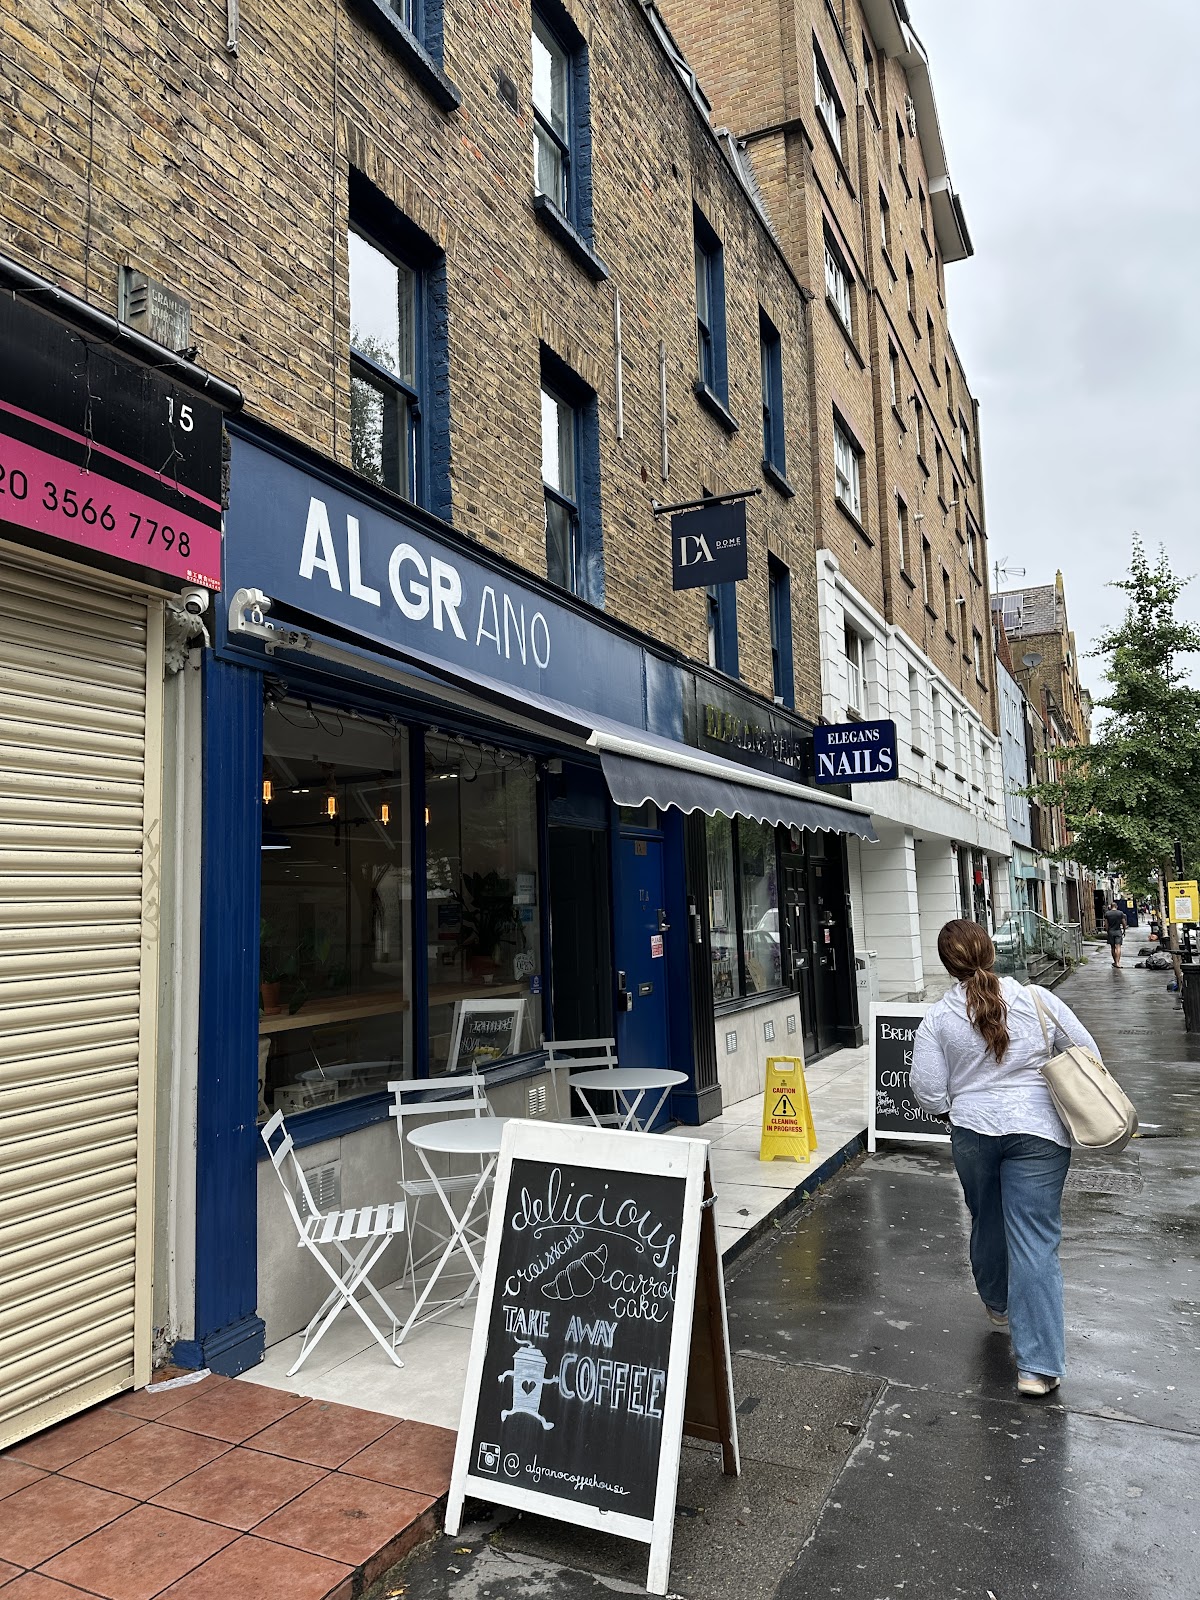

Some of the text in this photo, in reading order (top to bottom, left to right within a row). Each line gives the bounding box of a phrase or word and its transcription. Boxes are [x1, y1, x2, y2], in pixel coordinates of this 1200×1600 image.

[165, 396, 194, 432] 15
[42, 481, 116, 531] 3566
[129, 512, 191, 558] 7798
[715, 536, 741, 547] DOME
[827, 728, 880, 746] ELEGANS
[817, 747, 893, 777] NAILS
[880, 1023, 916, 1042] BREAK
[880, 1070, 910, 1088] COFF
[771, 1118, 798, 1126] CLEANING
[773, 1125, 803, 1133] PROGRESS
[511, 1167, 676, 1268] delicious
[602, 1265, 678, 1302] carrot
[608, 1294, 669, 1323] cake
[503, 1305, 618, 1348] TAKE AWAY
[558, 1352, 666, 1419] COFFEE
